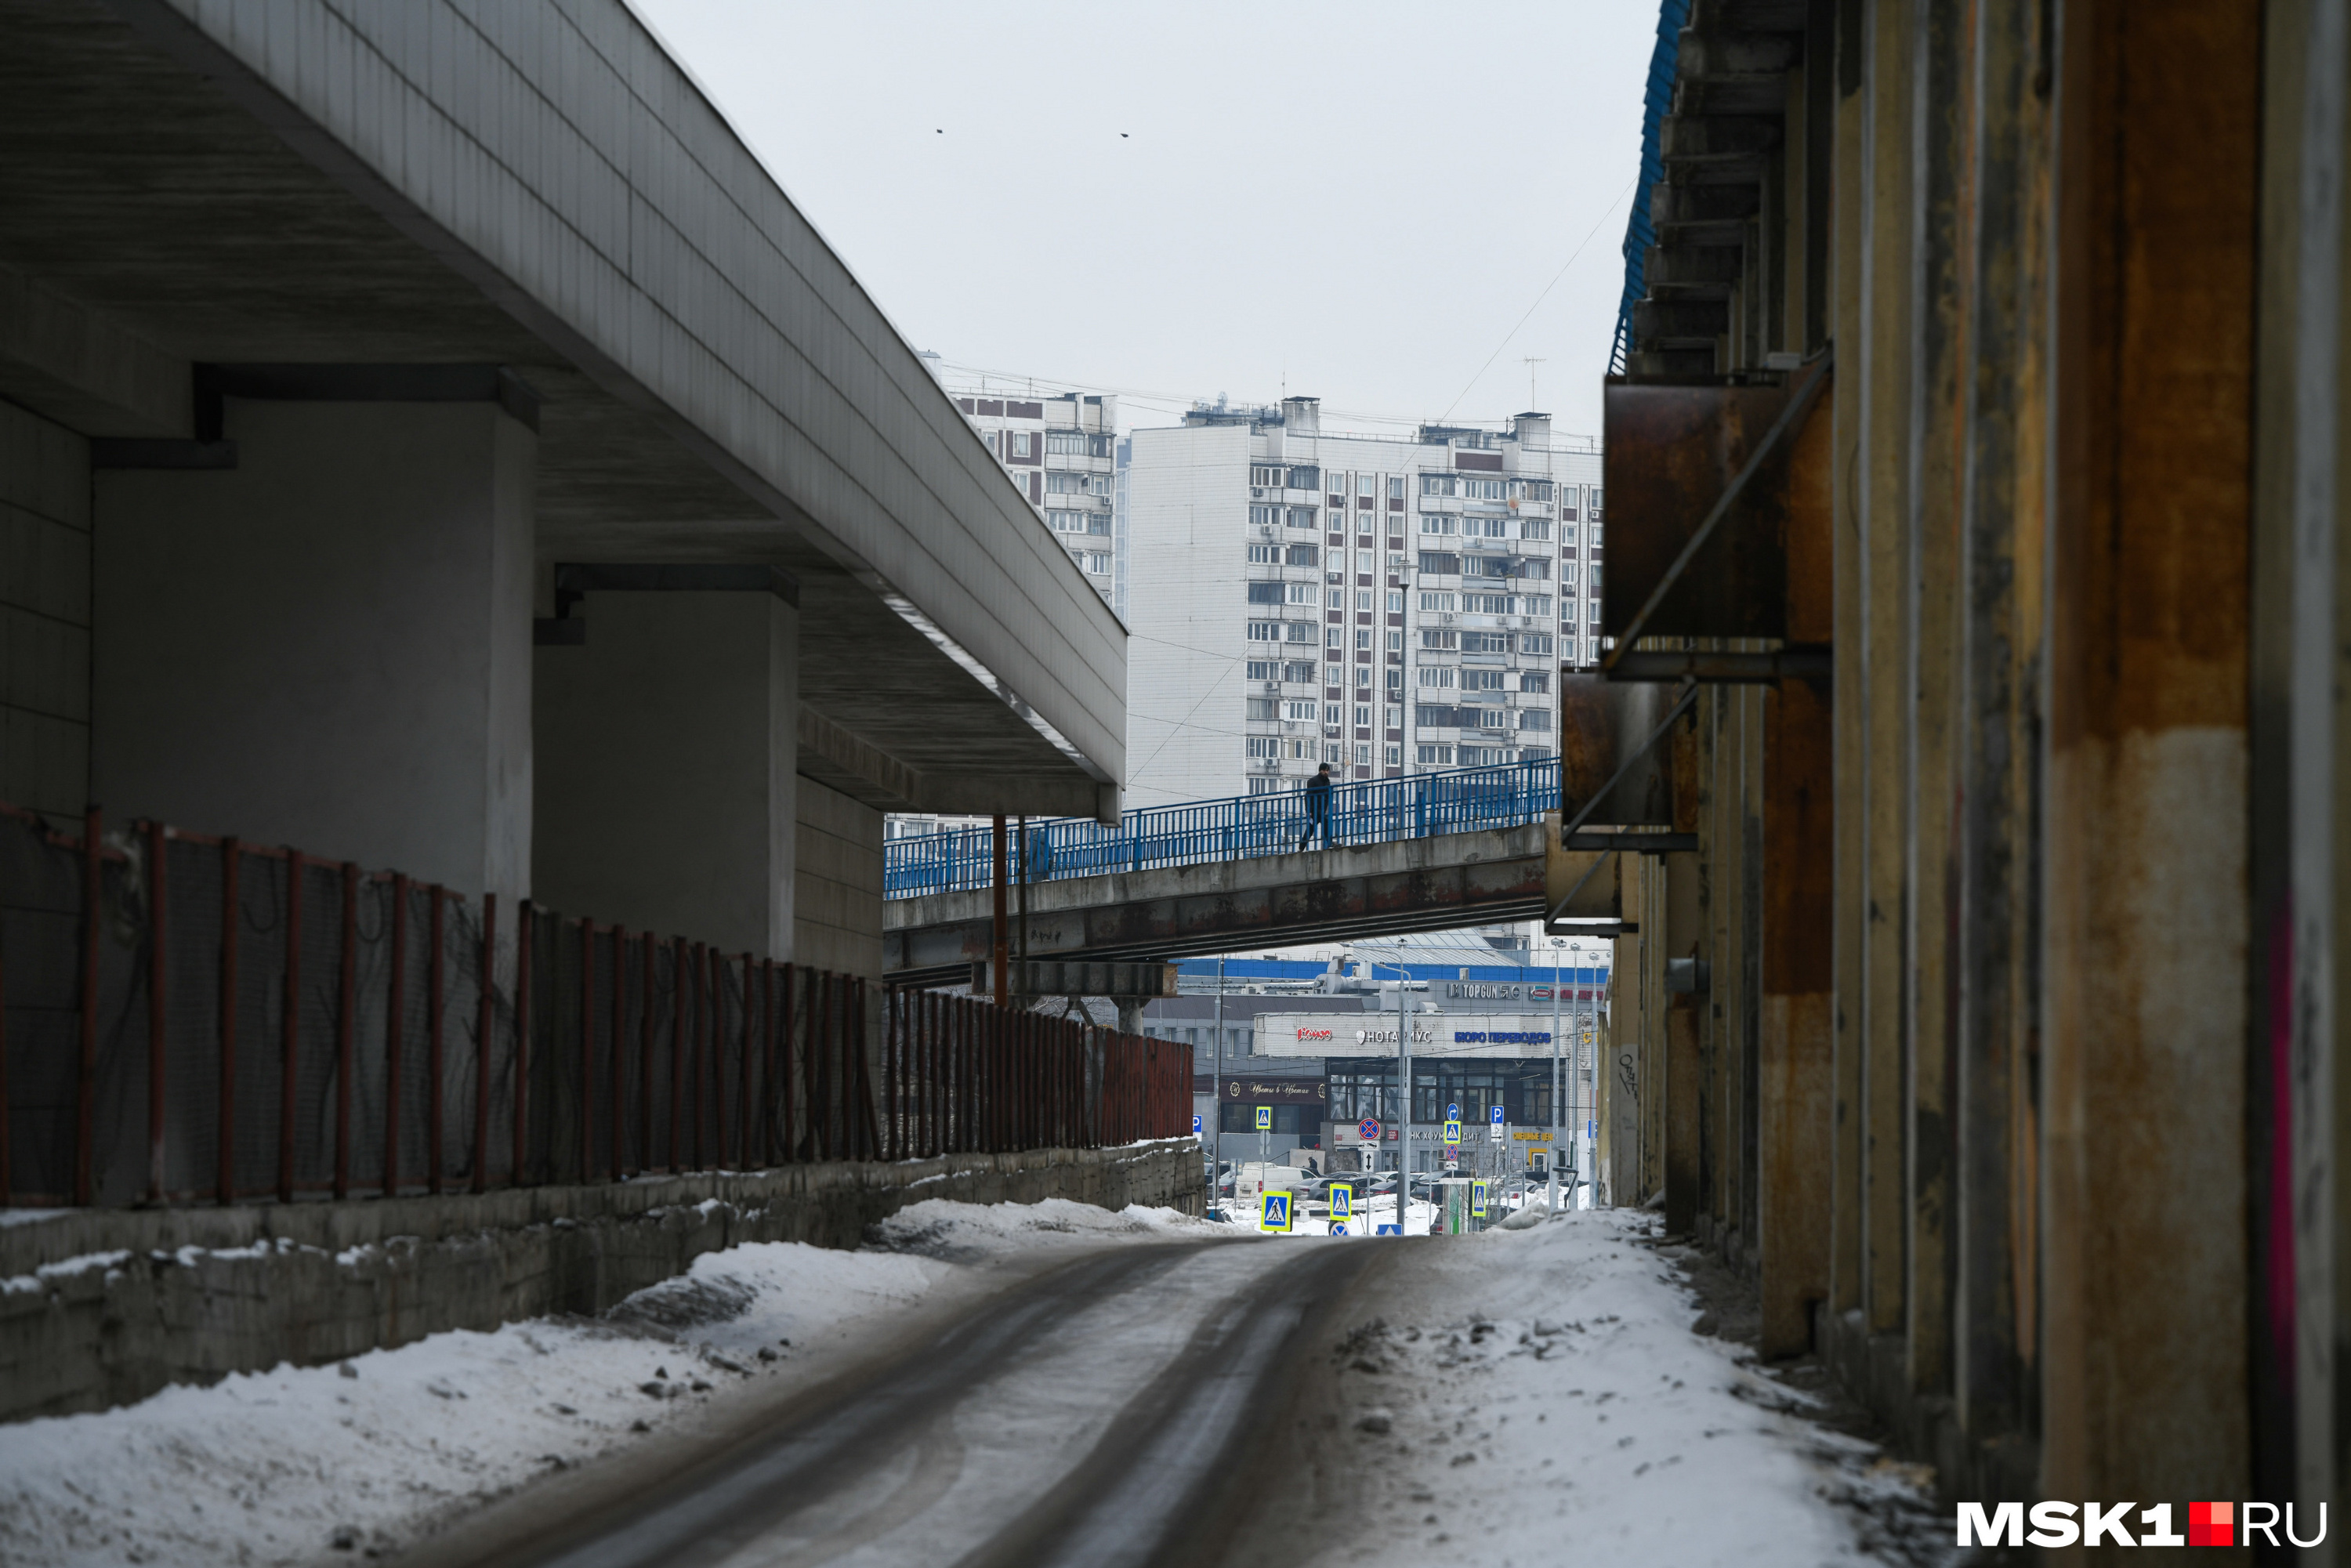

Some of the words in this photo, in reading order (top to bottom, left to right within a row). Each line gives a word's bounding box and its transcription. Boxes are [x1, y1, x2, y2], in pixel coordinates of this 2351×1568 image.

[1463, 984, 1498, 998] TOPGUN
[1367, 1031, 1432, 1043] НОТАИУС
[1454, 1031, 1487, 1043] БЮРО
[1488, 1032, 1551, 1045] ПЕРЕВОДОВ
[1541, 1132, 1553, 1141] ЦЕН
